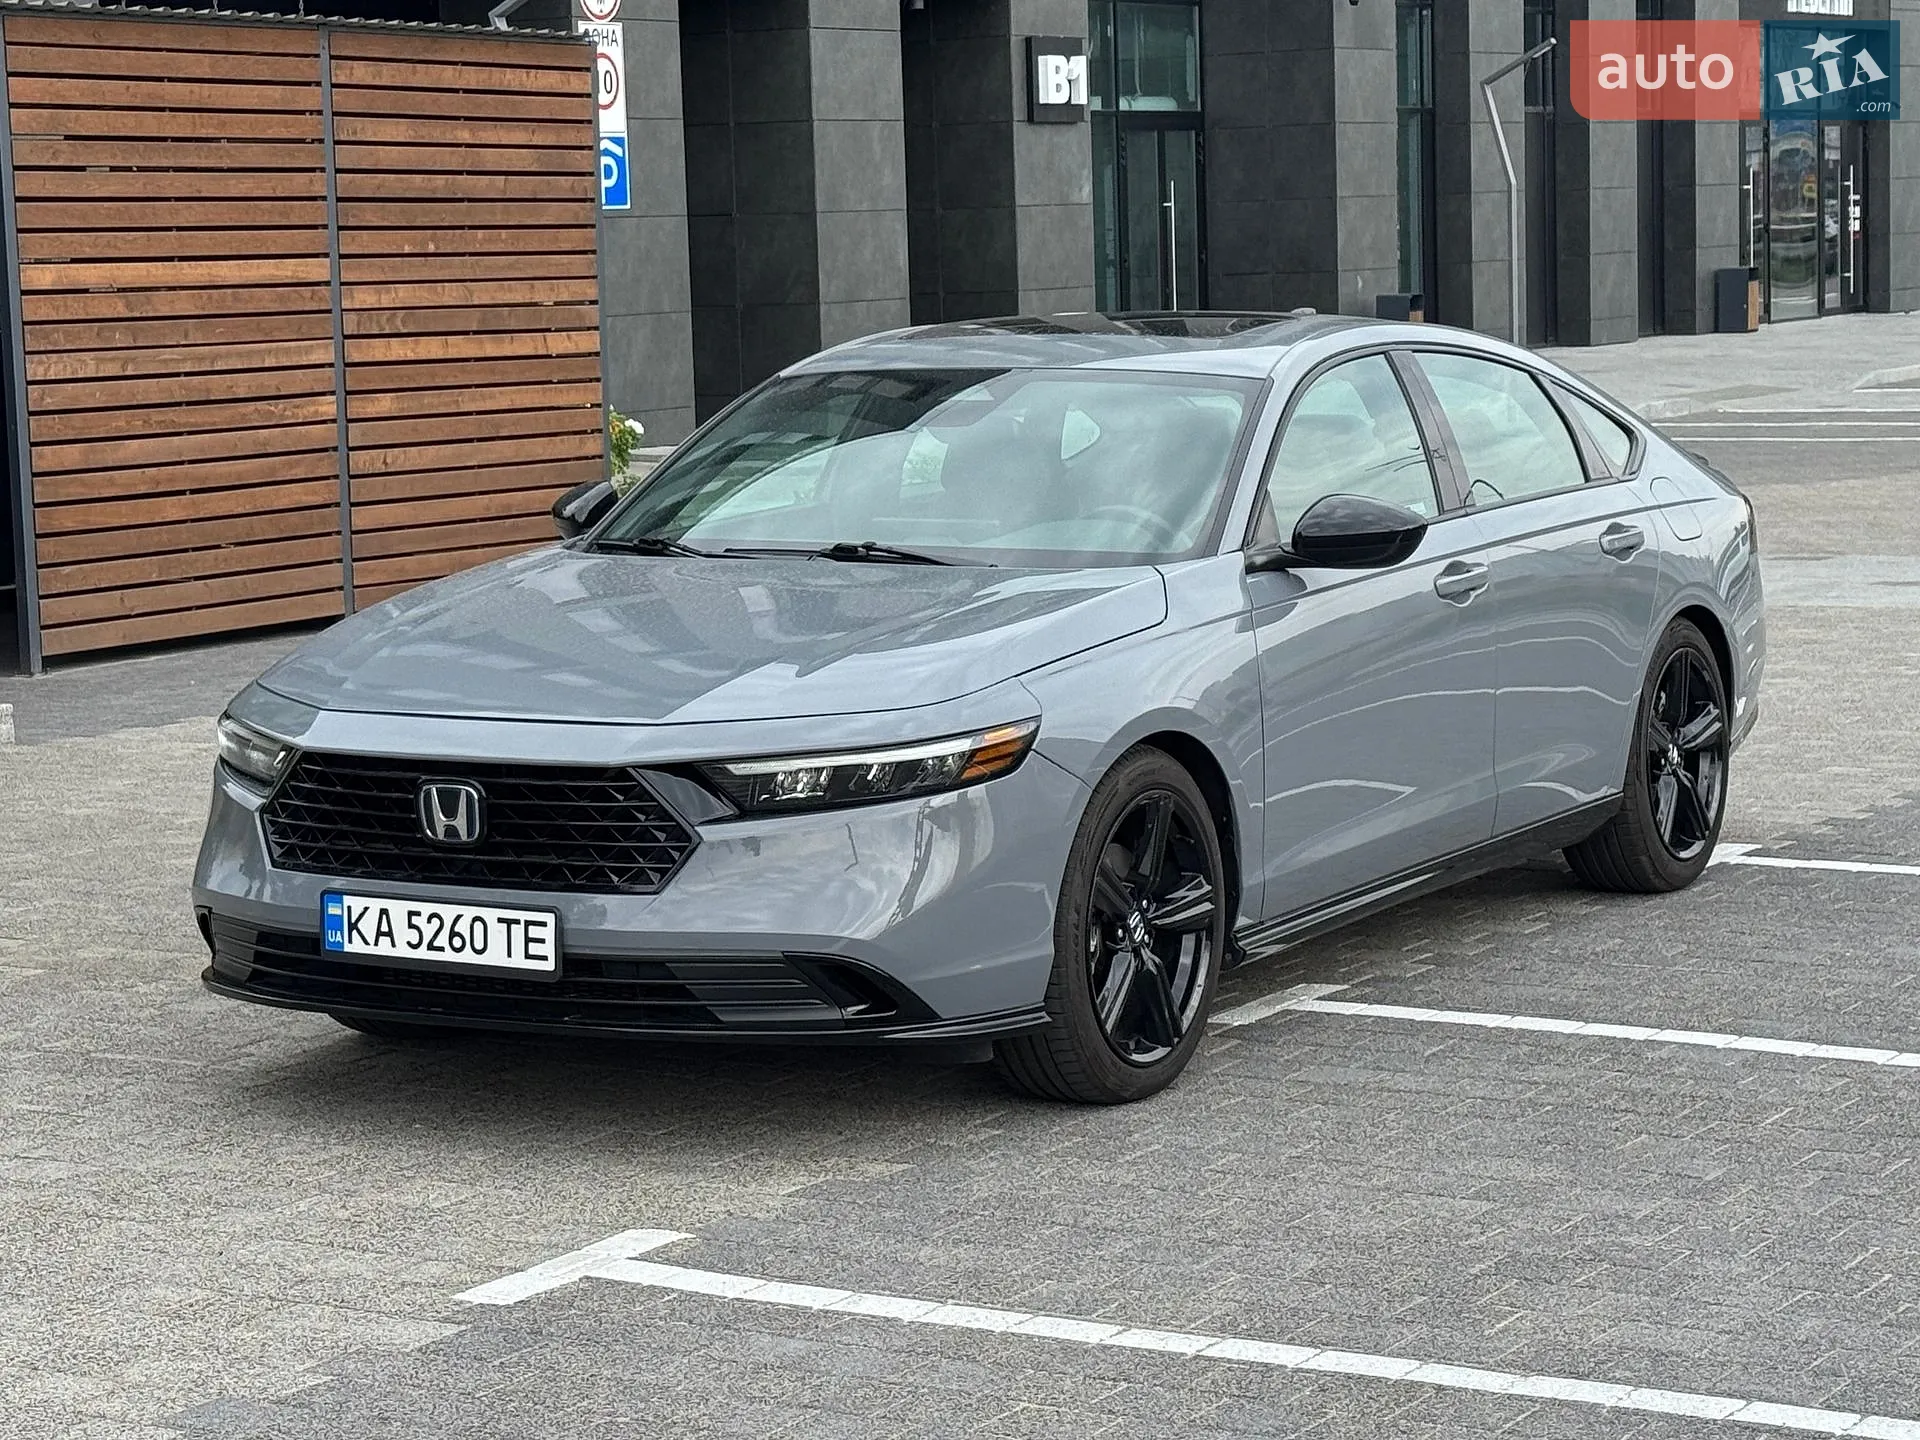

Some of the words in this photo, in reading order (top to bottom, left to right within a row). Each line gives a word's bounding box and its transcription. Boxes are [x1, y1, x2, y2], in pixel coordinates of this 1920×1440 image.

[1038, 54, 1088, 105] B1
[601, 155, 619, 205] P
[328, 930, 343, 943] UA
[346, 905, 397, 948] KA
[406, 910, 488, 955] 5260
[496, 917, 549, 961] TE
